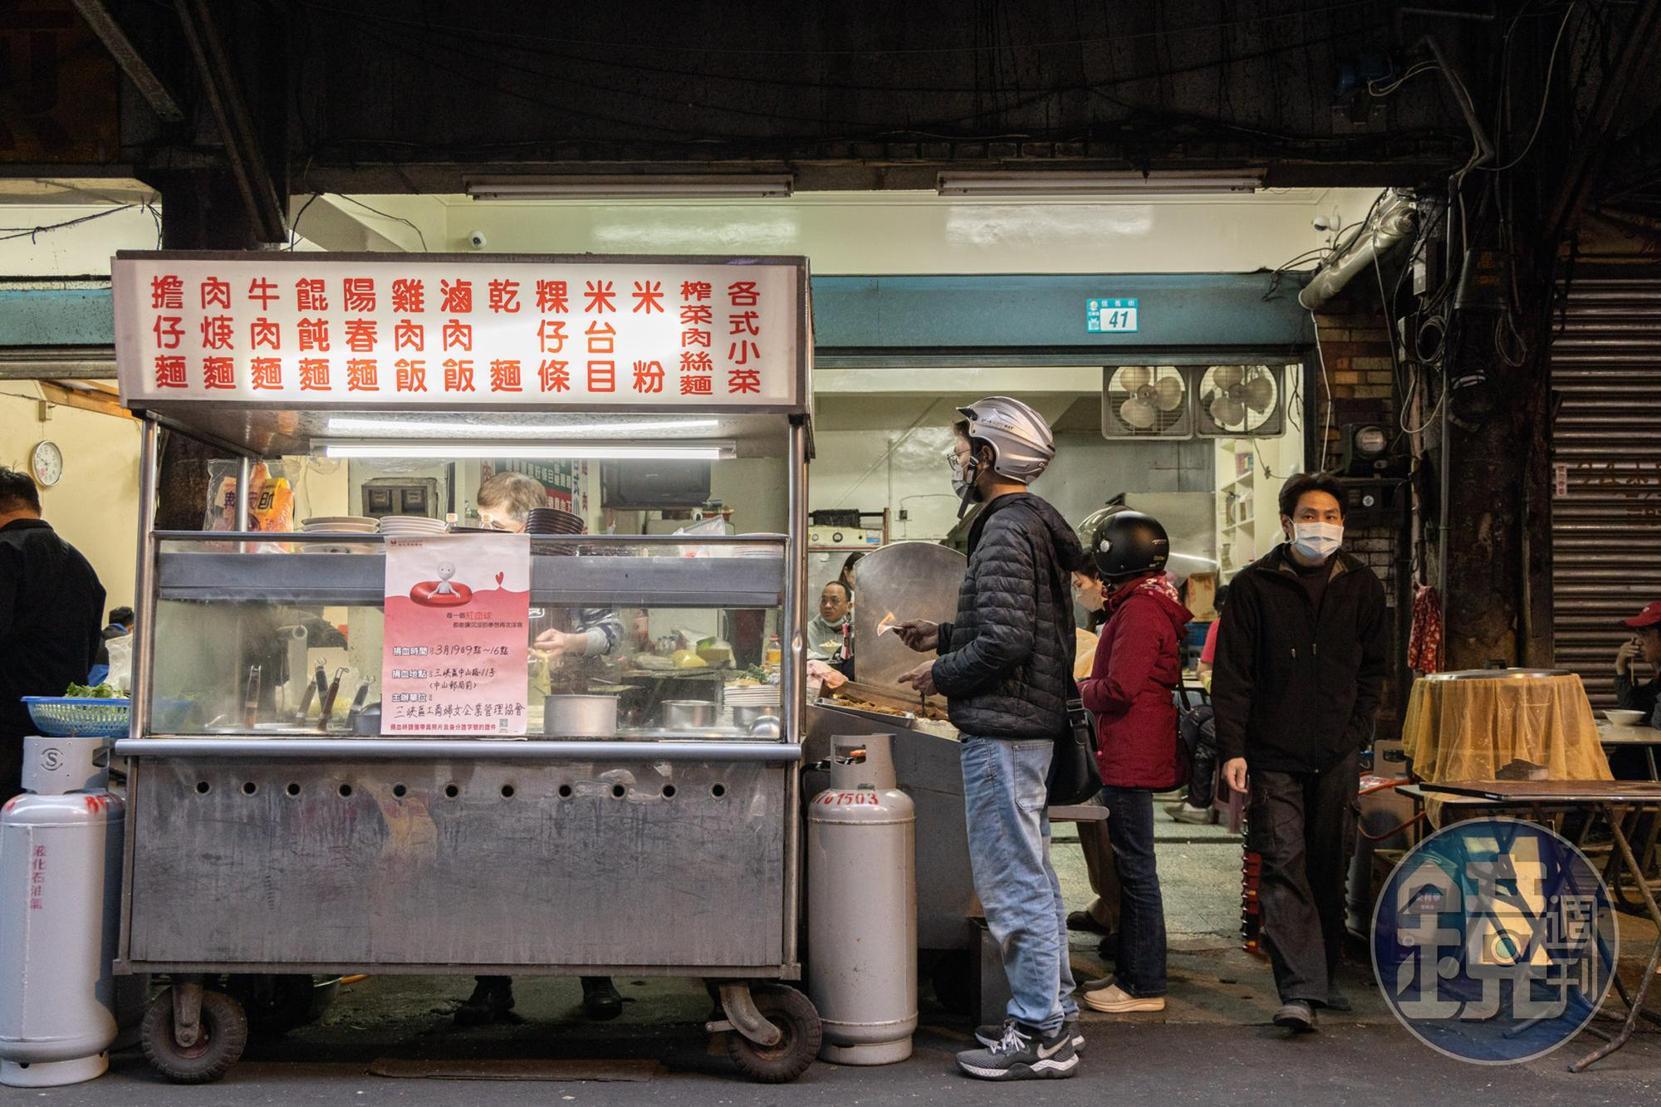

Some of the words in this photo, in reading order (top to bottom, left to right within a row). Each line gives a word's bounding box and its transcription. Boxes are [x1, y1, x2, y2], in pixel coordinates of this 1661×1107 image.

[150, 274, 189, 389] 擔仔麵
[199, 275, 237, 390] 肉焿麵
[248, 276, 284, 390] 牛肉麵
[295, 277, 332, 391] 餛飩麵
[342, 277, 380, 391] 陽春麵
[391, 277, 428, 392] 雞肉飯
[439, 278, 476, 392] 滷肉飯
[488, 279, 523, 392] 乾麵
[535, 279, 570, 393] 粿仔條
[583, 280, 617, 393] 米台目
[631, 280, 666, 394] 米粉
[679, 281, 714, 396] 榨菜肉絲麵
[727, 280, 761, 394] 各式小菜
[1109, 311, 1128, 328] 41
